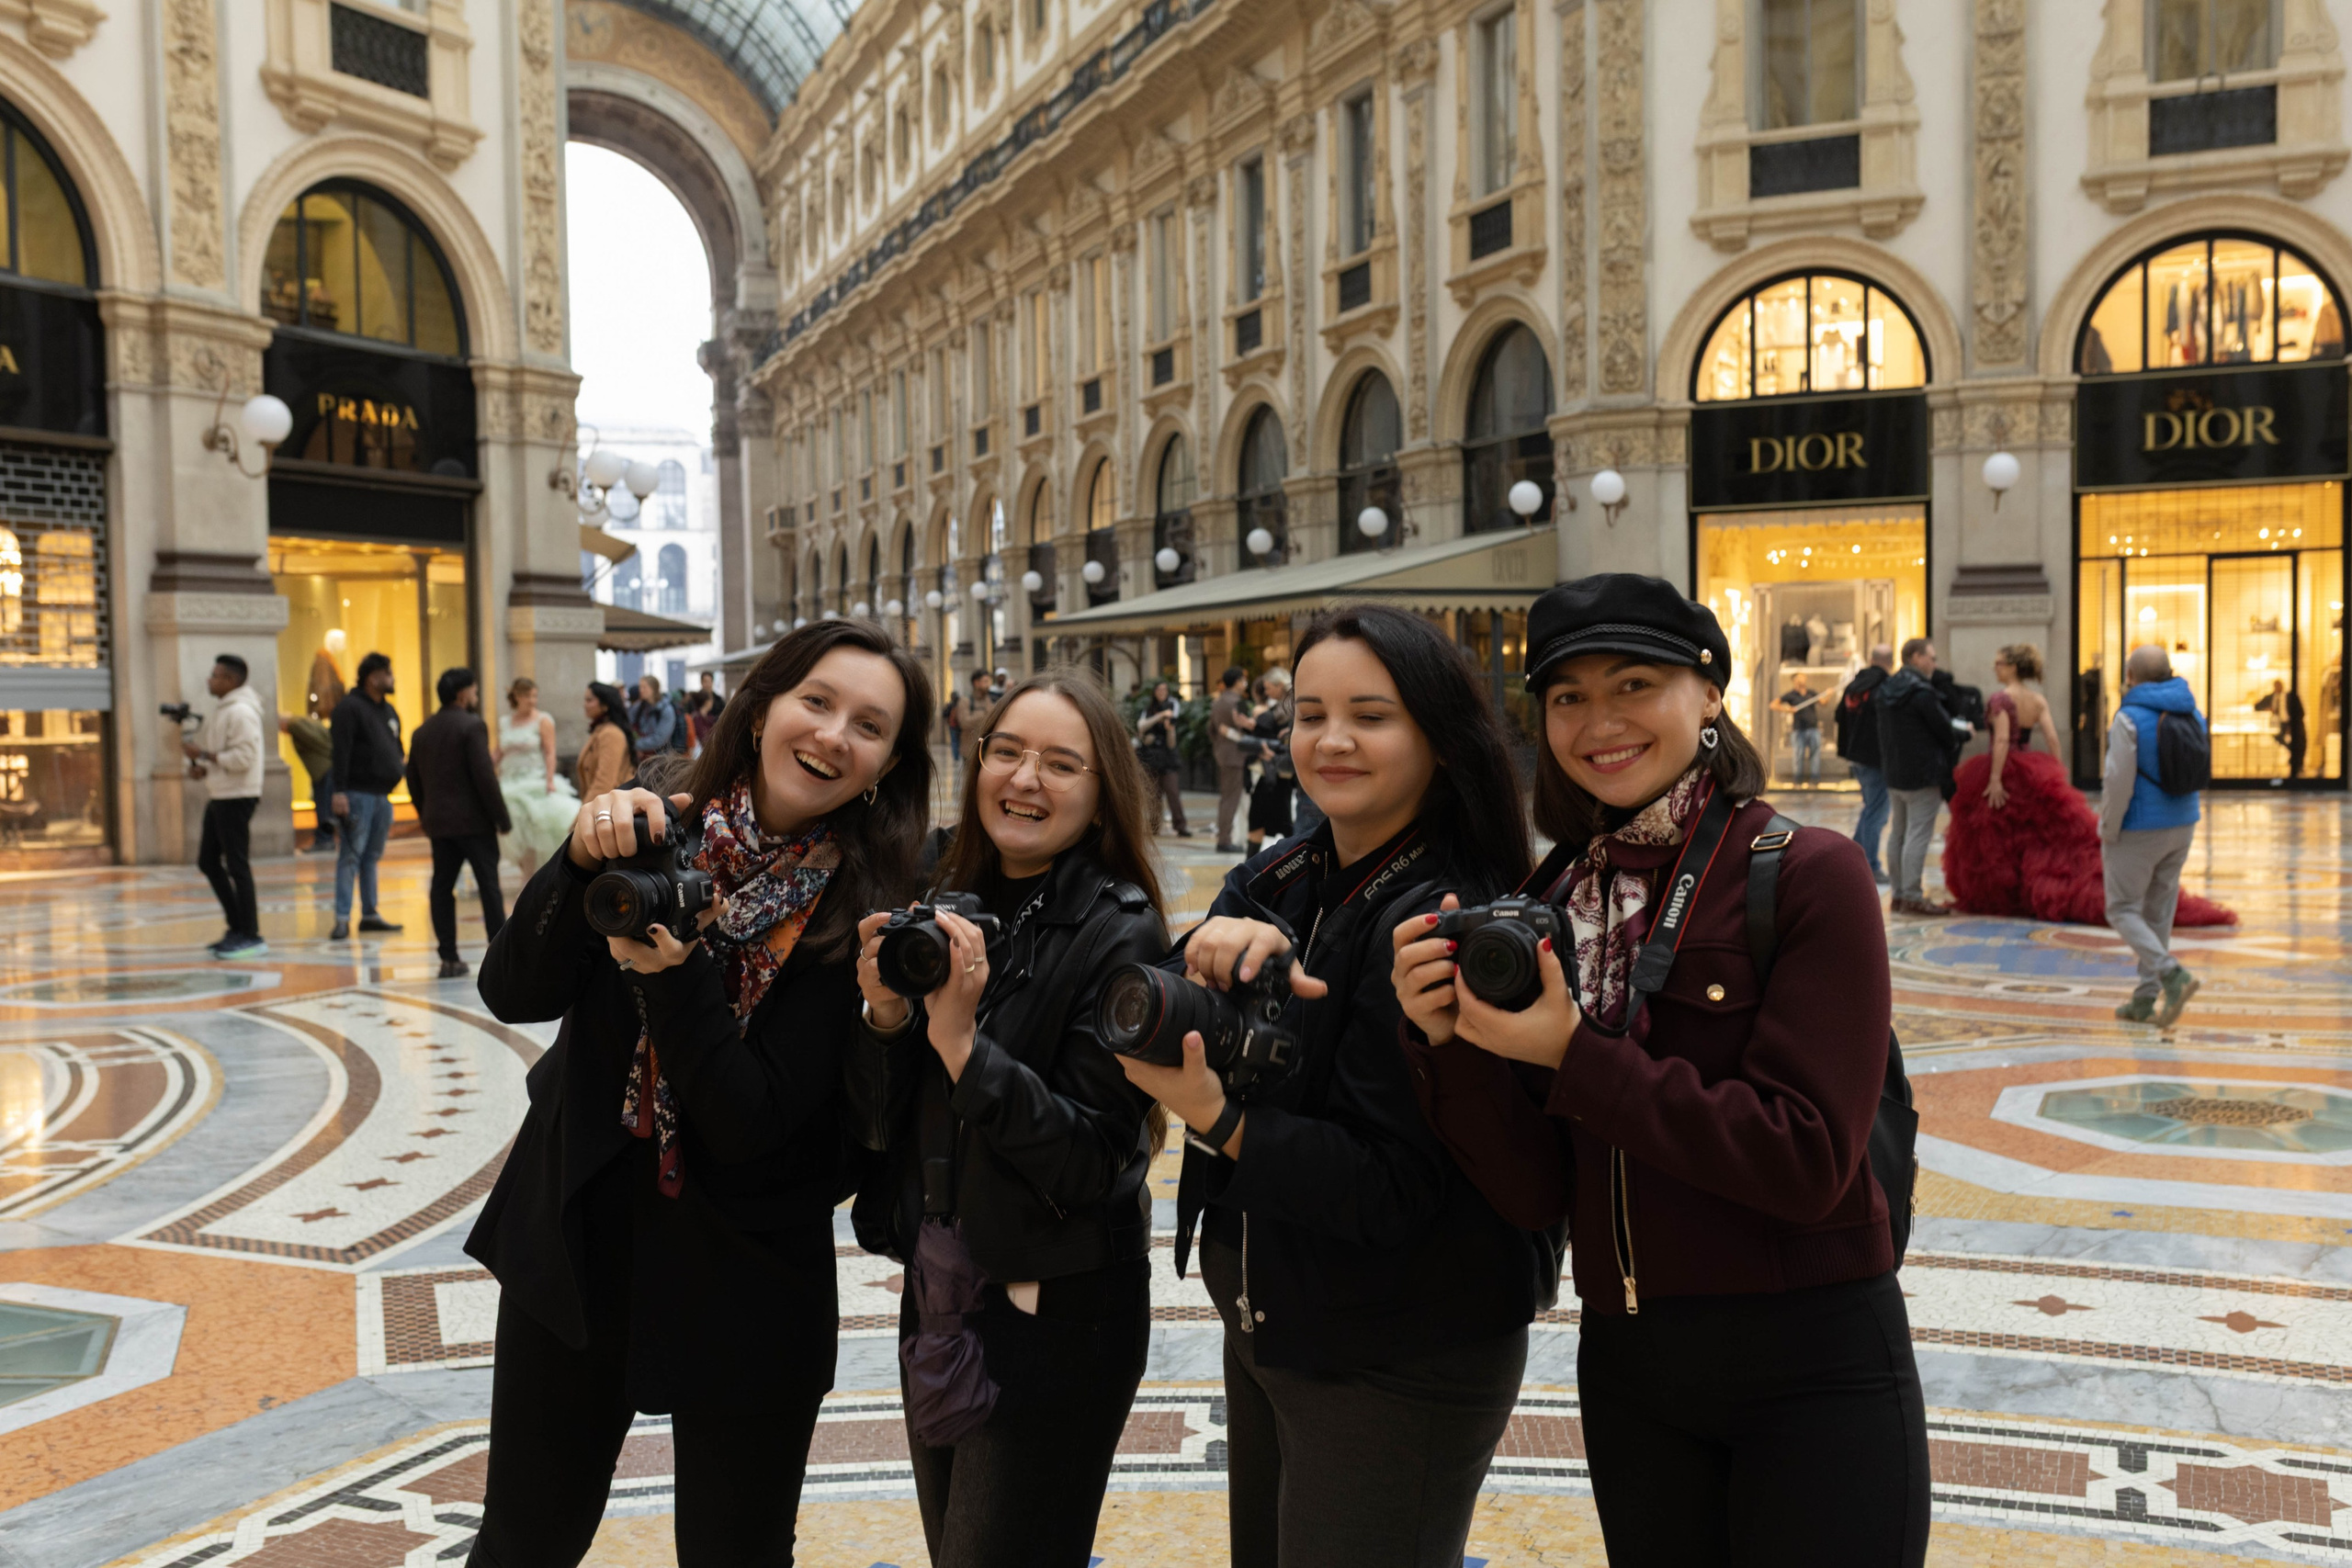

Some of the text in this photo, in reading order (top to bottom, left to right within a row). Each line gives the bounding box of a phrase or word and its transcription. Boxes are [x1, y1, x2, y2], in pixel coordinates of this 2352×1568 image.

[317, 393, 419, 431] PRADA
[2143, 405, 2280, 451] DIOR
[1748, 431, 1869, 474] DIOR
[1391, 854, 1410, 873] R6
[676, 882, 685, 908] Canon
[1013, 892, 1045, 936] ONY
[1492, 908, 1520, 917] Canon
[1662, 873, 1695, 929] Canon
